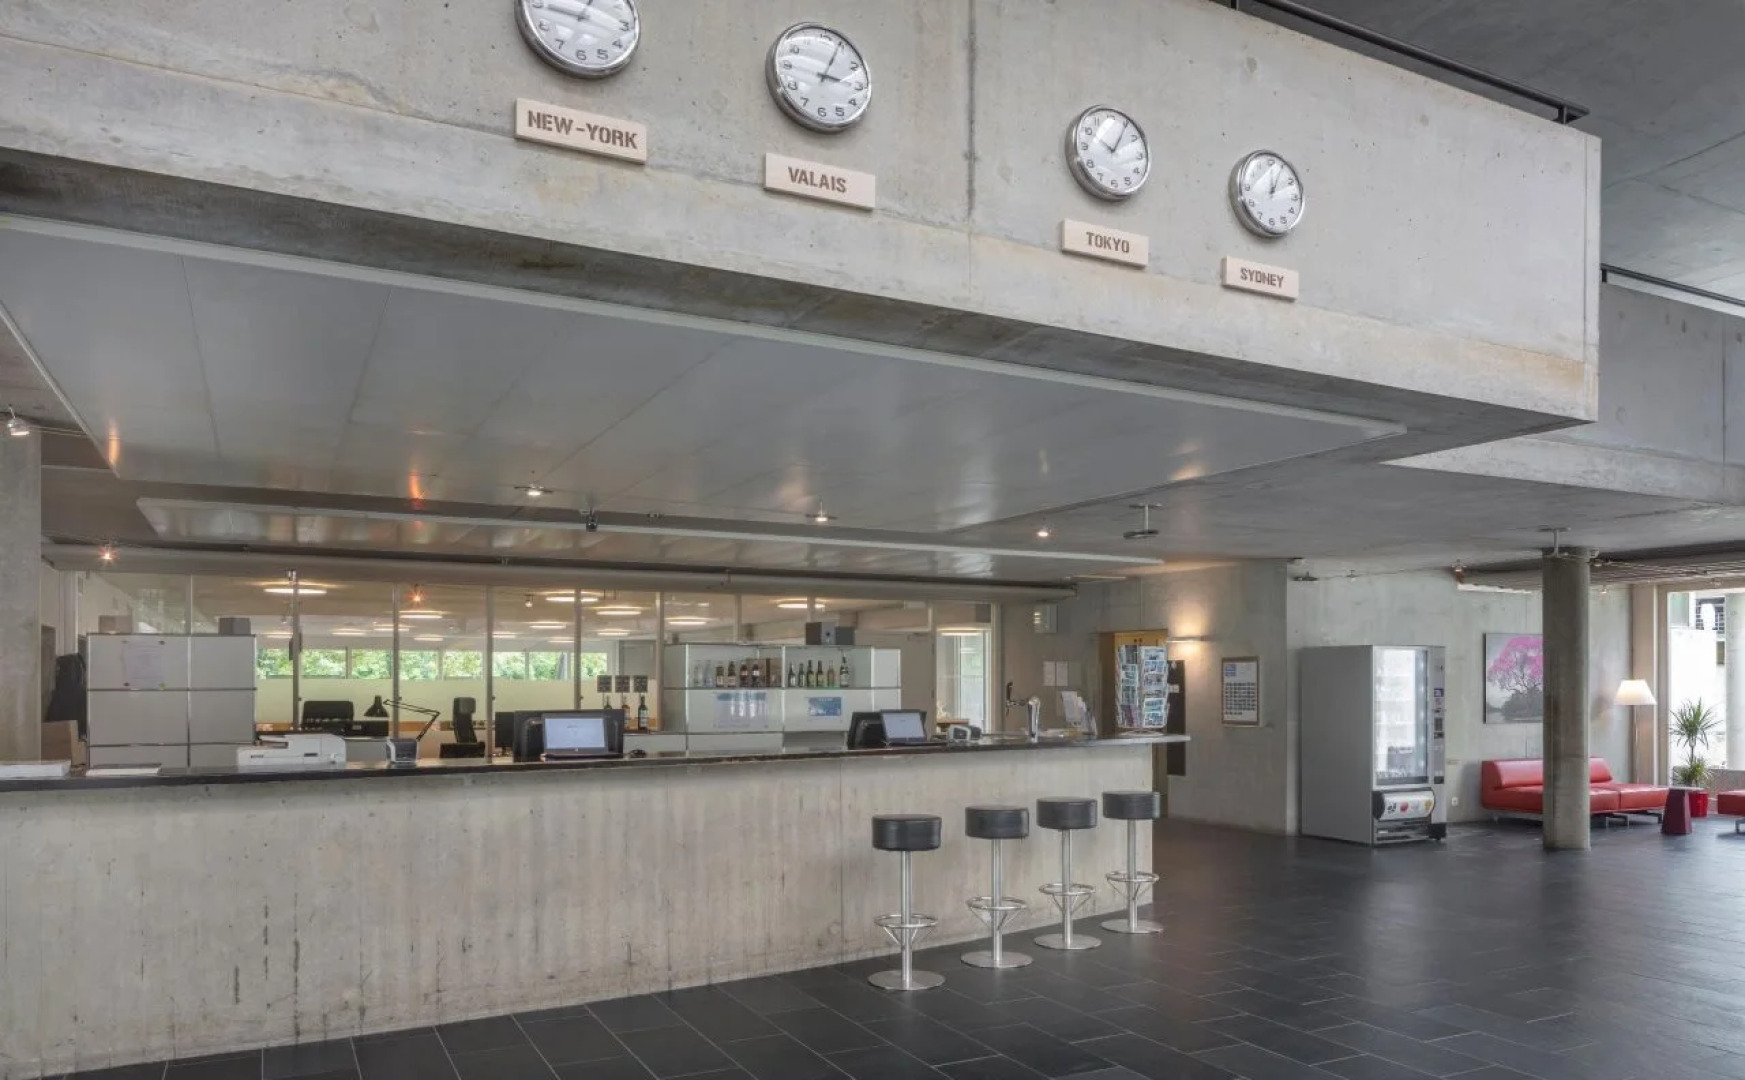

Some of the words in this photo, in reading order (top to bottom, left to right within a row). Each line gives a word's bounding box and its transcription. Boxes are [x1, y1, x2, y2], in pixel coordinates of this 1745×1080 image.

[619, 21, 629, 32] 3
[555, 38, 565, 49] 7
[612, 38, 623, 49] 4
[576, 49, 586, 60] 6
[596, 49, 608, 60] 5
[801, 96, 809, 106] 7
[817, 107, 827, 117] 6
[835, 106, 845, 117] 5
[528, 109, 639, 150] NEW-YORK
[788, 166, 846, 193] VALAIS
[1124, 177, 1132, 186] 5
[1086, 231, 1130, 254] TOKYO
[1240, 267, 1285, 289] SYDNEY
